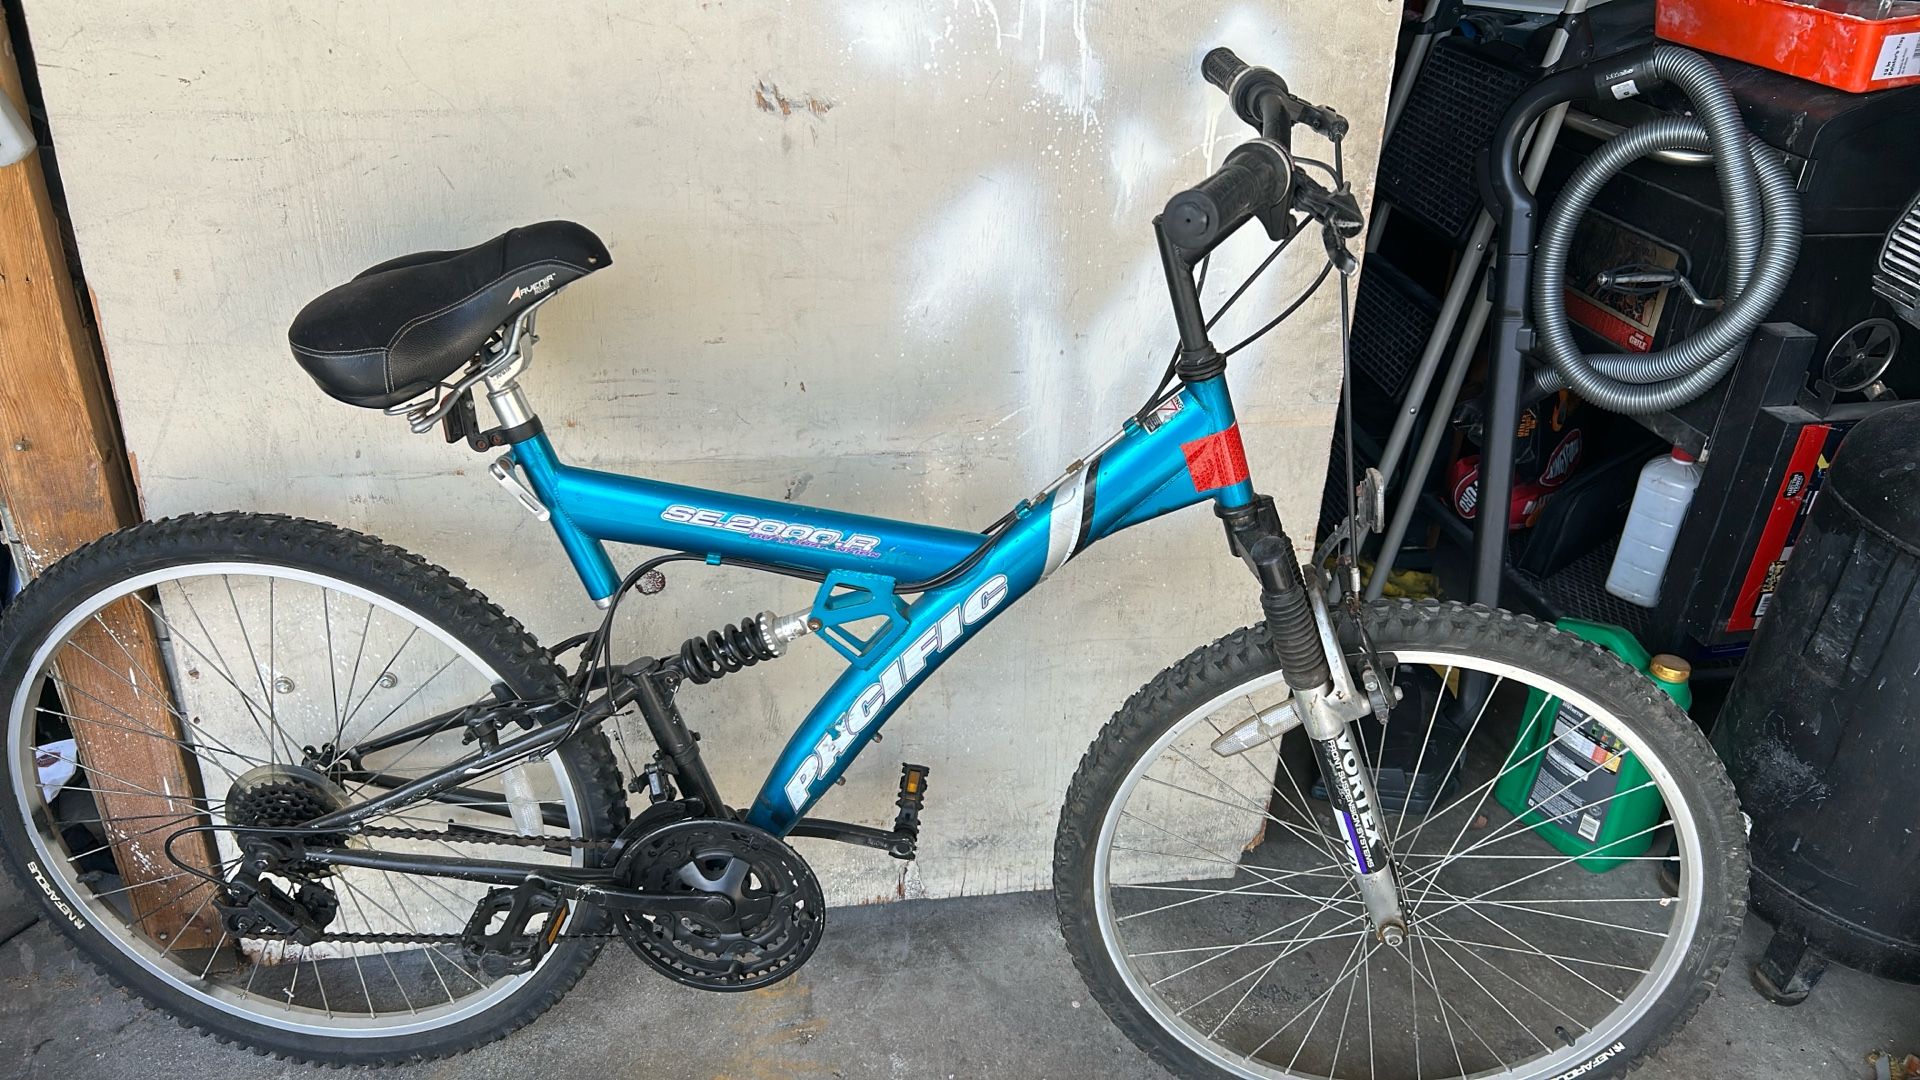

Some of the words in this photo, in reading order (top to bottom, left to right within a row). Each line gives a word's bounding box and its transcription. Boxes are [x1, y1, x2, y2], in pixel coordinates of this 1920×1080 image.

[1328, 739, 1344, 770] FRONT
[1338, 770, 1361, 828] SUSPENSION
[1355, 827, 1375, 868] SYSTEMS
